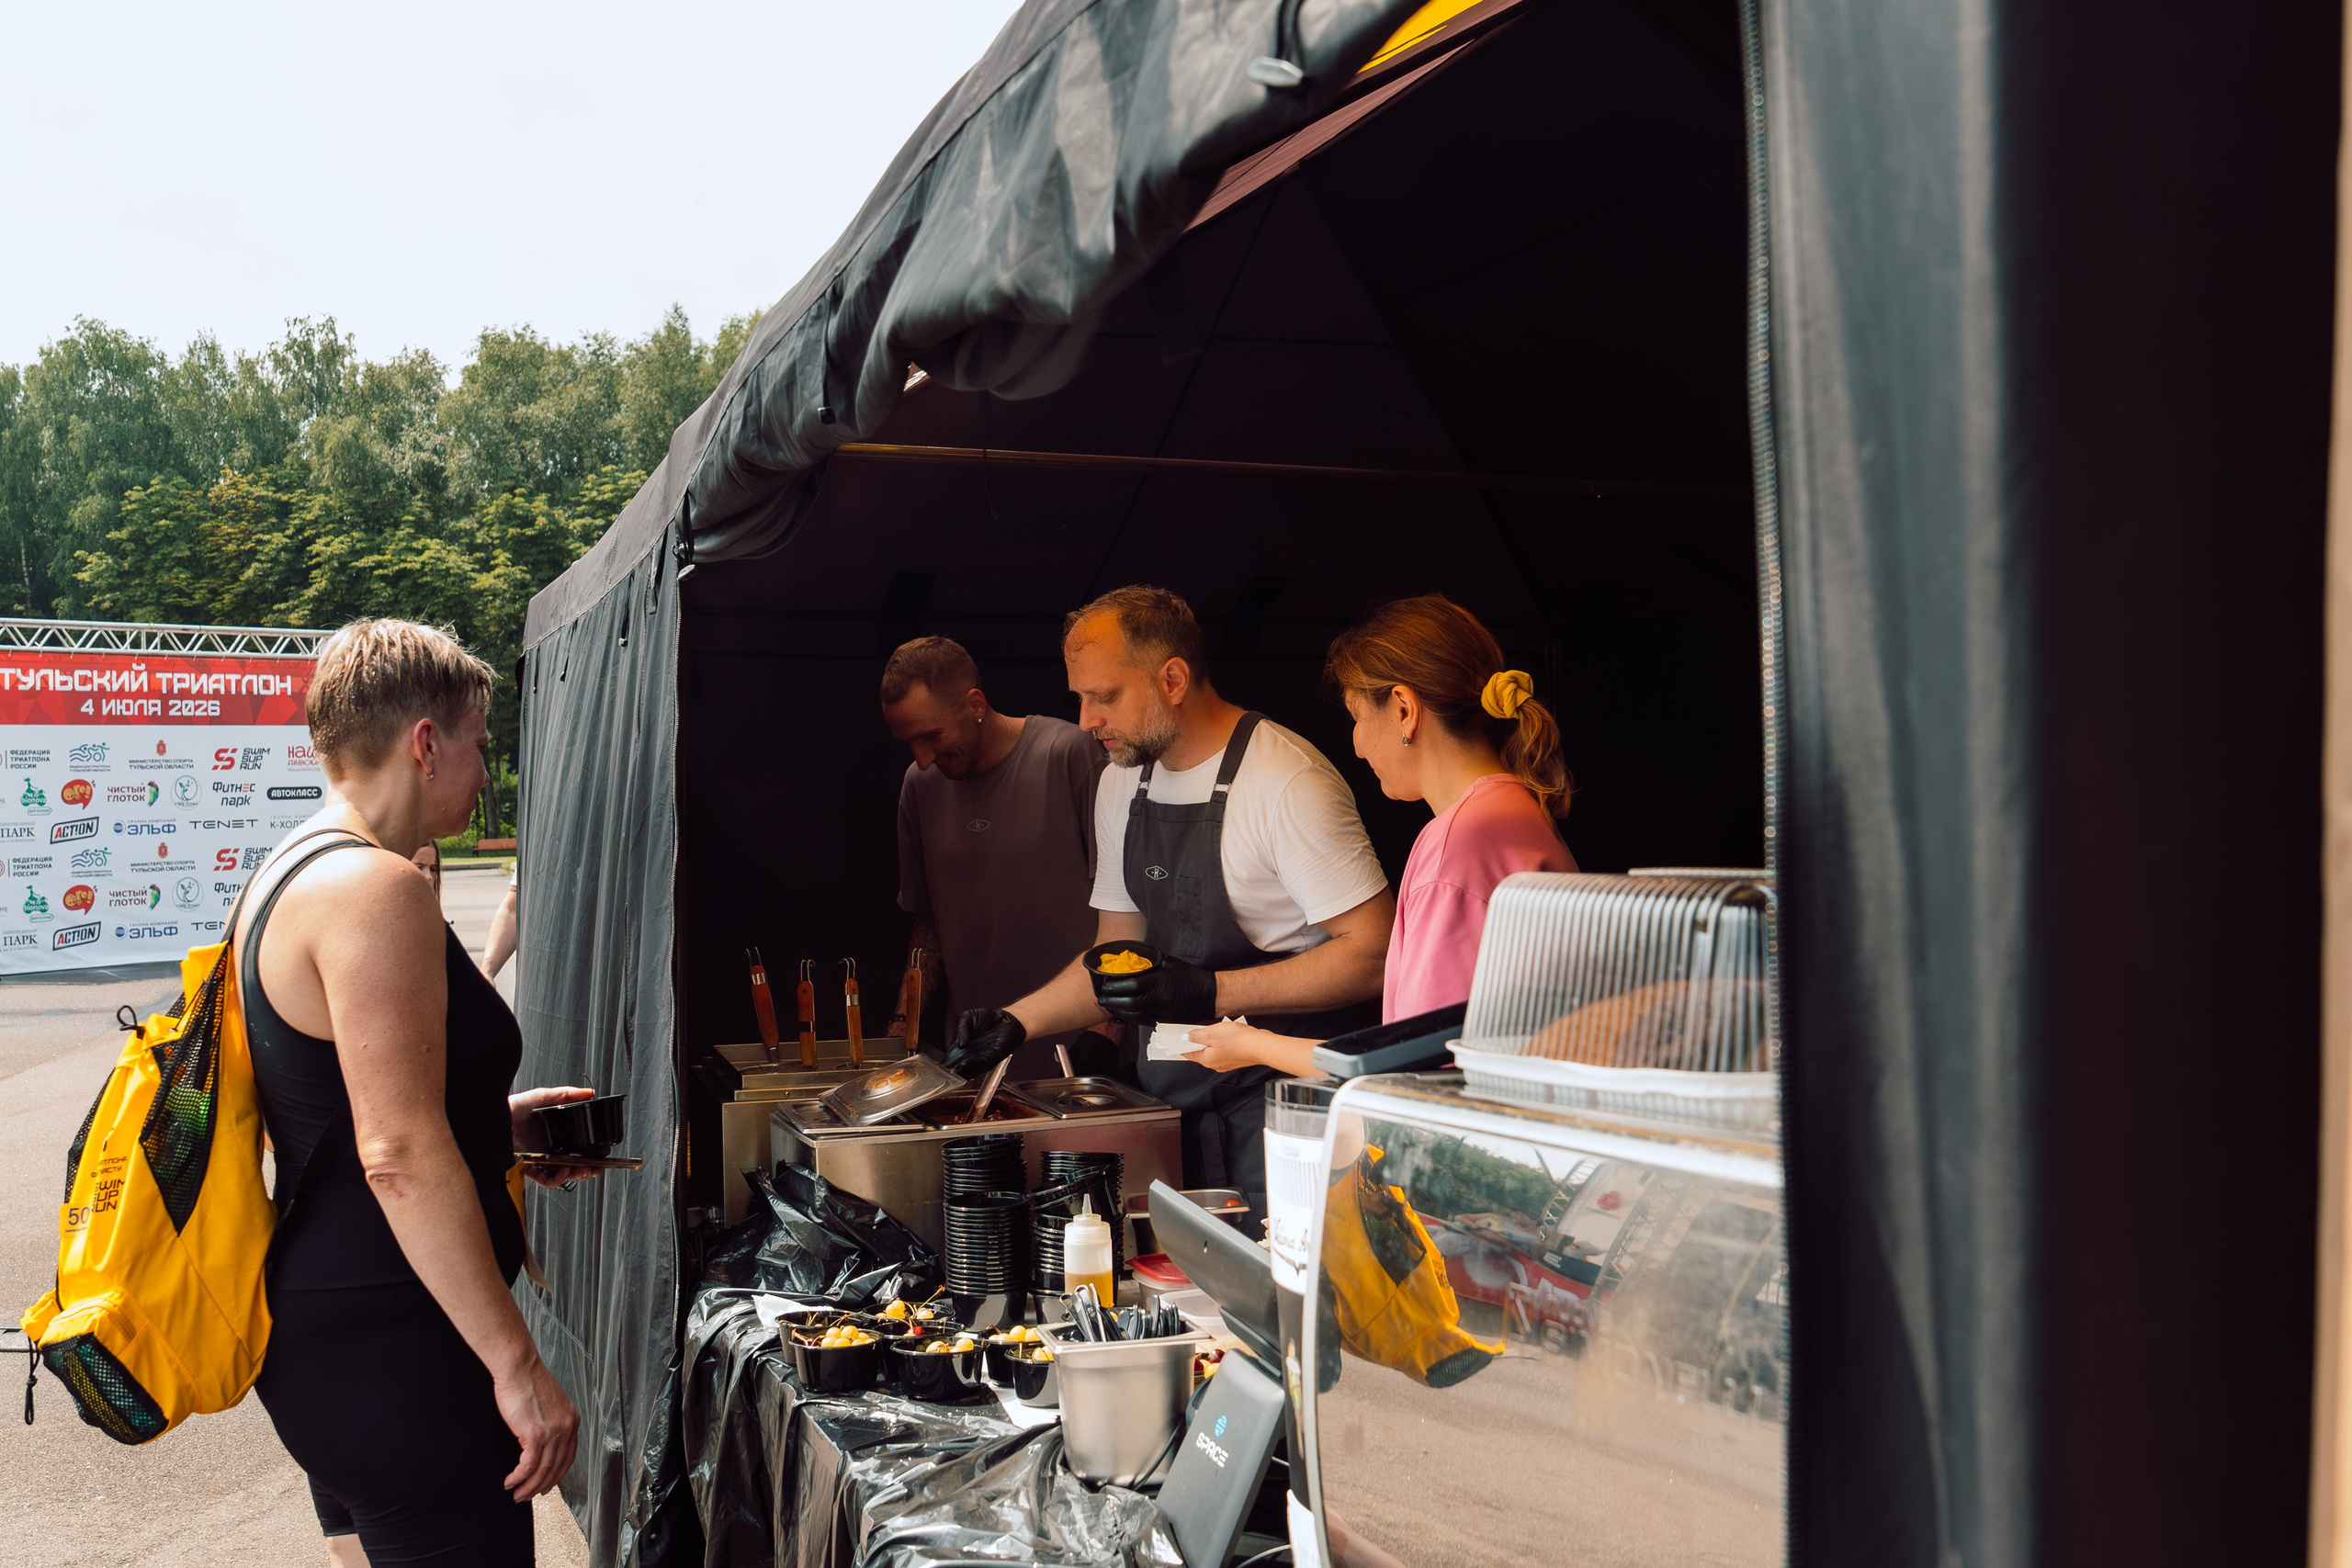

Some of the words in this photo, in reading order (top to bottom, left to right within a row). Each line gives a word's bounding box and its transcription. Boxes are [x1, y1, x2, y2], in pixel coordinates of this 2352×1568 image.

[0, 663, 148, 693] ТУЛЬСКИЙ
[155, 672, 292, 695] ТРИАТЛОН
[80, 698, 95, 716] 4
[102, 699, 162, 716] ИЮЛЯ
[168, 699, 220, 716] 2026
[107, 783, 146, 794] ЧИСТЫЙ
[271, 788, 319, 797] АВТОКЛАСС
[127, 824, 176, 836] ЭЛЬФ
[189, 819, 258, 829] TENET
[0, 827, 36, 838] ПАРК
[109, 886, 147, 897] ЧИСТЫЙ
[109, 897, 147, 907] ГЛОТОК
[129, 926, 178, 939] ЭЛЬФ
[3, 934, 39, 946] ПАРК
[94, 1190, 119, 1202] UP
[1196, 1432, 1229, 1468] SPACE
